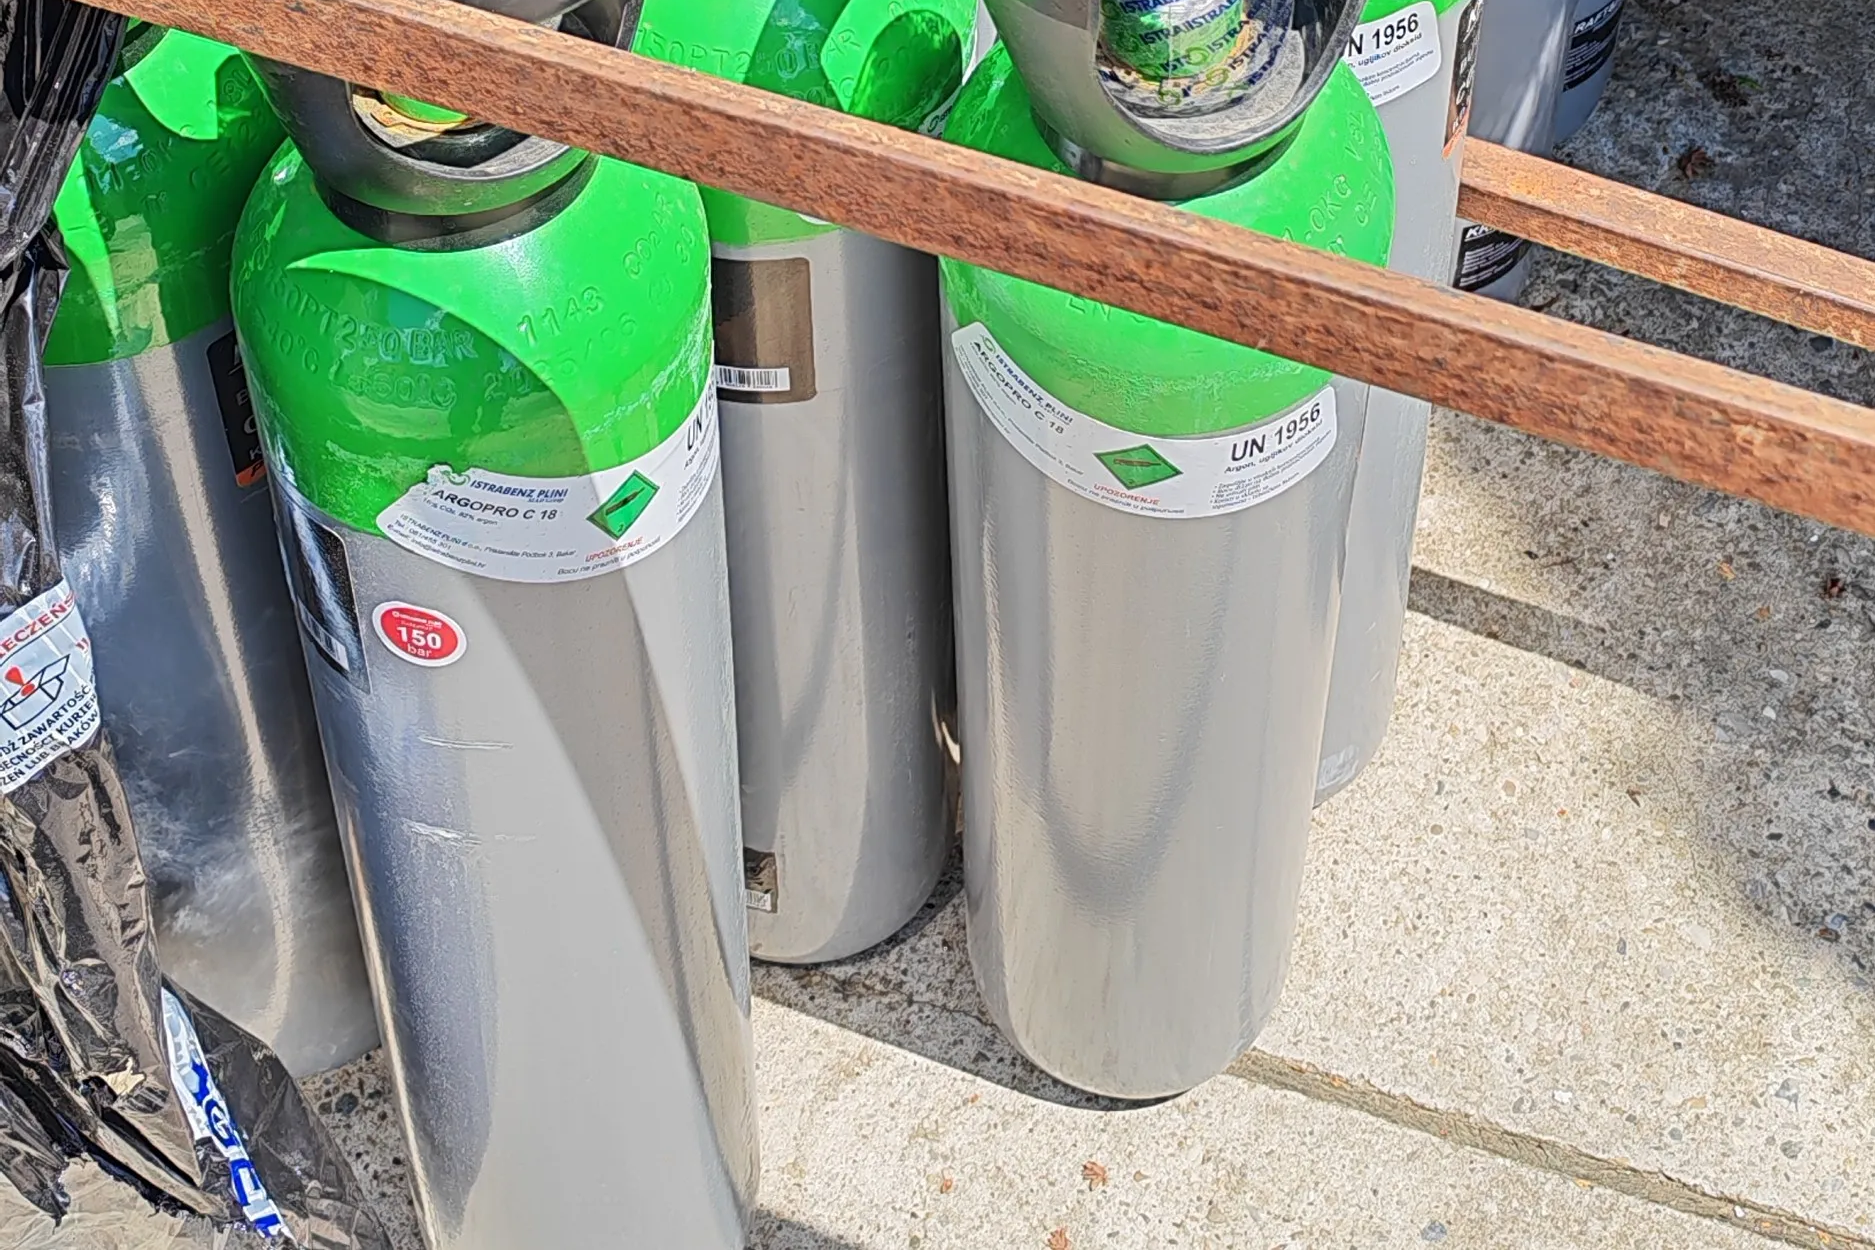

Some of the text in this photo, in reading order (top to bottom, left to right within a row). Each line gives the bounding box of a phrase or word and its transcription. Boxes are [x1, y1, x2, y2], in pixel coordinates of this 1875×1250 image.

[1347, 12, 1419, 58] N 1956
[973, 341, 1065, 435] ARGOPRO C 18
[995, 353, 1074, 424] ISTRABENZ PLINI
[1230, 401, 1321, 462] UN 1956
[431, 488, 559, 521] ARGOPRO C 18
[470, 478, 569, 500] ISTRABENZ PLINI
[1093, 482, 1161, 506] UPOZORENJE
[396, 626, 443, 651] 150
[407, 643, 433, 658] bar
[20, 684, 92, 745] ZAWARTOŚĆ
[26, 748, 51, 771] LUB
